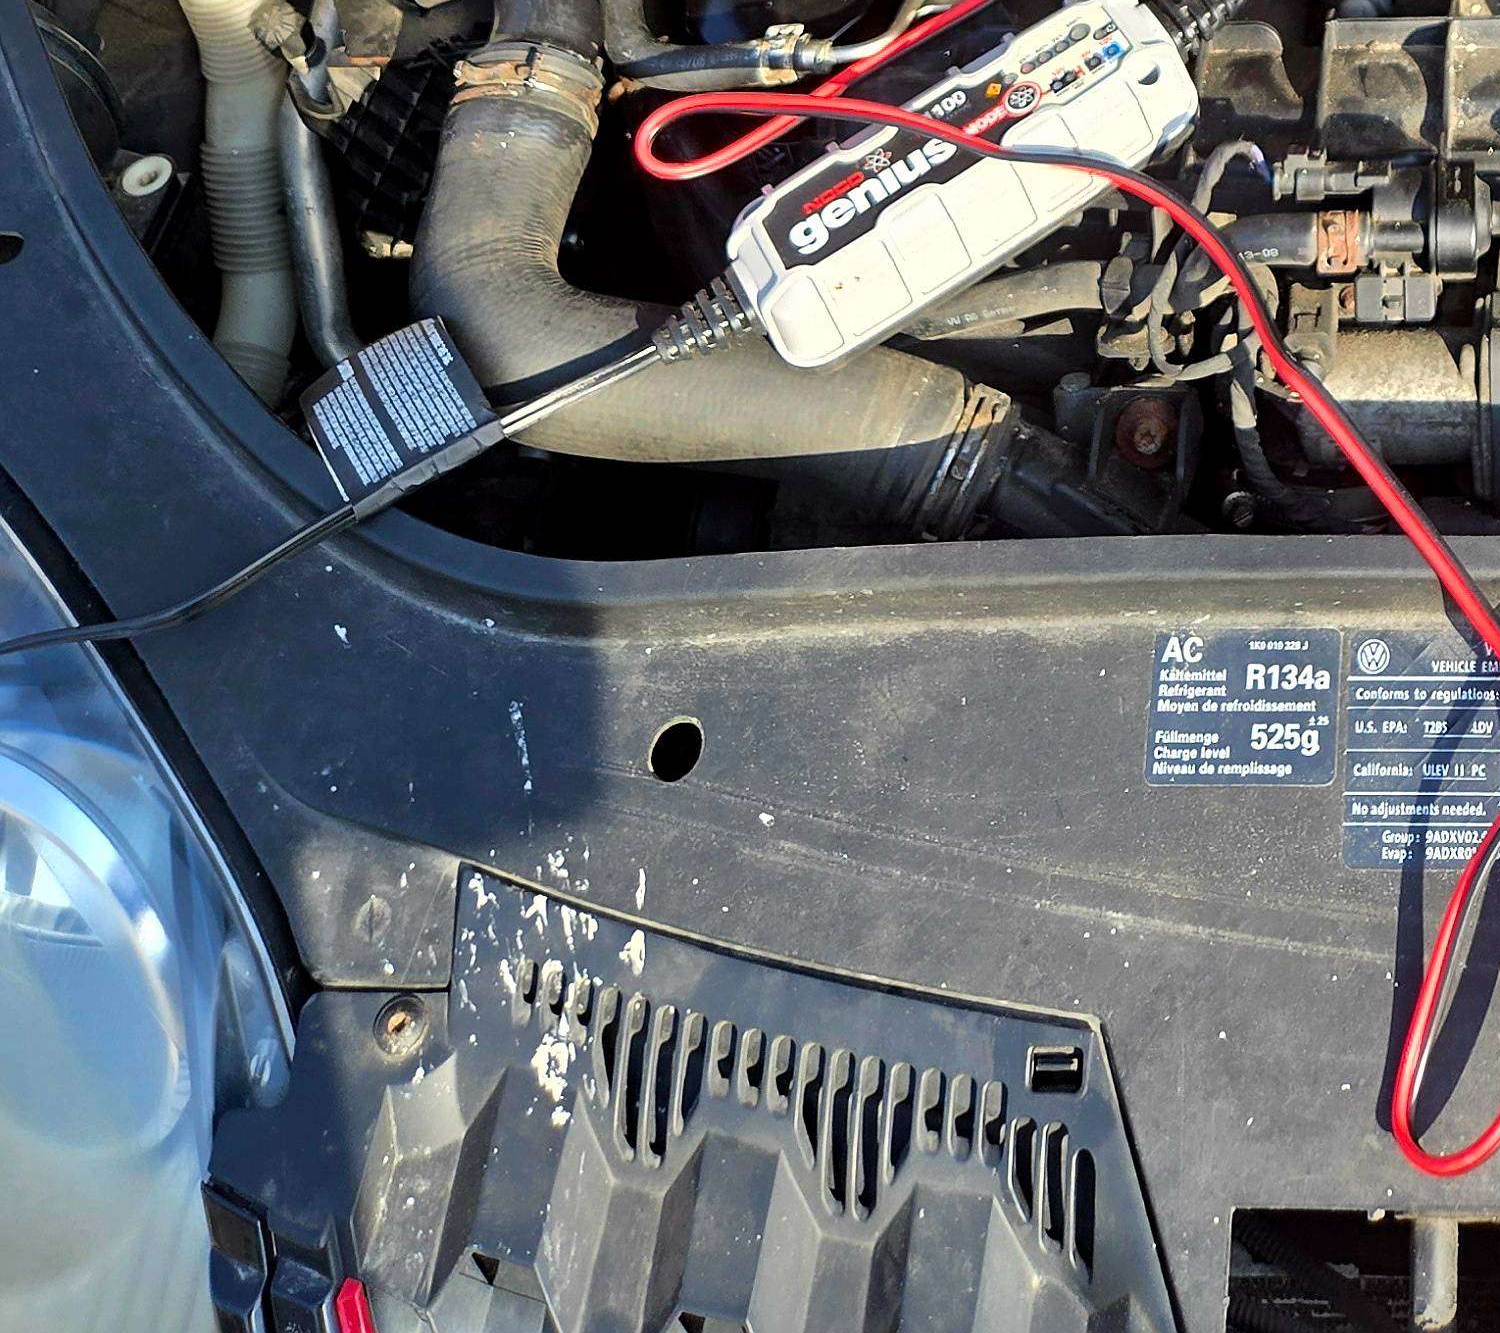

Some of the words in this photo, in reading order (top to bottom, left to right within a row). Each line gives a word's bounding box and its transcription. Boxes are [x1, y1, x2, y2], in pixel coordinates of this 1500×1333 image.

[788, 137, 958, 256] genius
[1160, 636, 1203, 664] AC
[1431, 660, 1476, 673] VEHICLE
[1159, 668, 1227, 682] Kältemittel
[1245, 663, 1331, 690] R134a
[1158, 684, 1227, 699] Refrigerant
[1355, 687, 1409, 701] Conforms
[1414, 687, 1427, 700] to
[1431, 687, 1500, 704] regulations:
[1157, 699, 1199, 714] Moyen
[1201, 699, 1218, 712] de
[1220, 699, 1316, 712] refroidissement
[1354, 721, 1377, 734] U.S.
[1382, 721, 1408, 734] EPA:
[1155, 730, 1219, 746] Füllmenge
[1250, 723, 1321, 757] 525g
[1153, 747, 1198, 762] Charge
[1200, 746, 1231, 759] level
[1152, 762, 1196, 775] Niveau
[1198, 762, 1215, 775] de
[1217, 762, 1293, 778] remplissage
[1353, 763, 1413, 777] California:
[1422, 763, 1449, 777] ULEV
[1471, 764, 1486, 777] PC
[1352, 802, 1368, 816] No
[1370, 802, 1439, 819] adjustments
[1441, 802, 1487, 816] needed.
